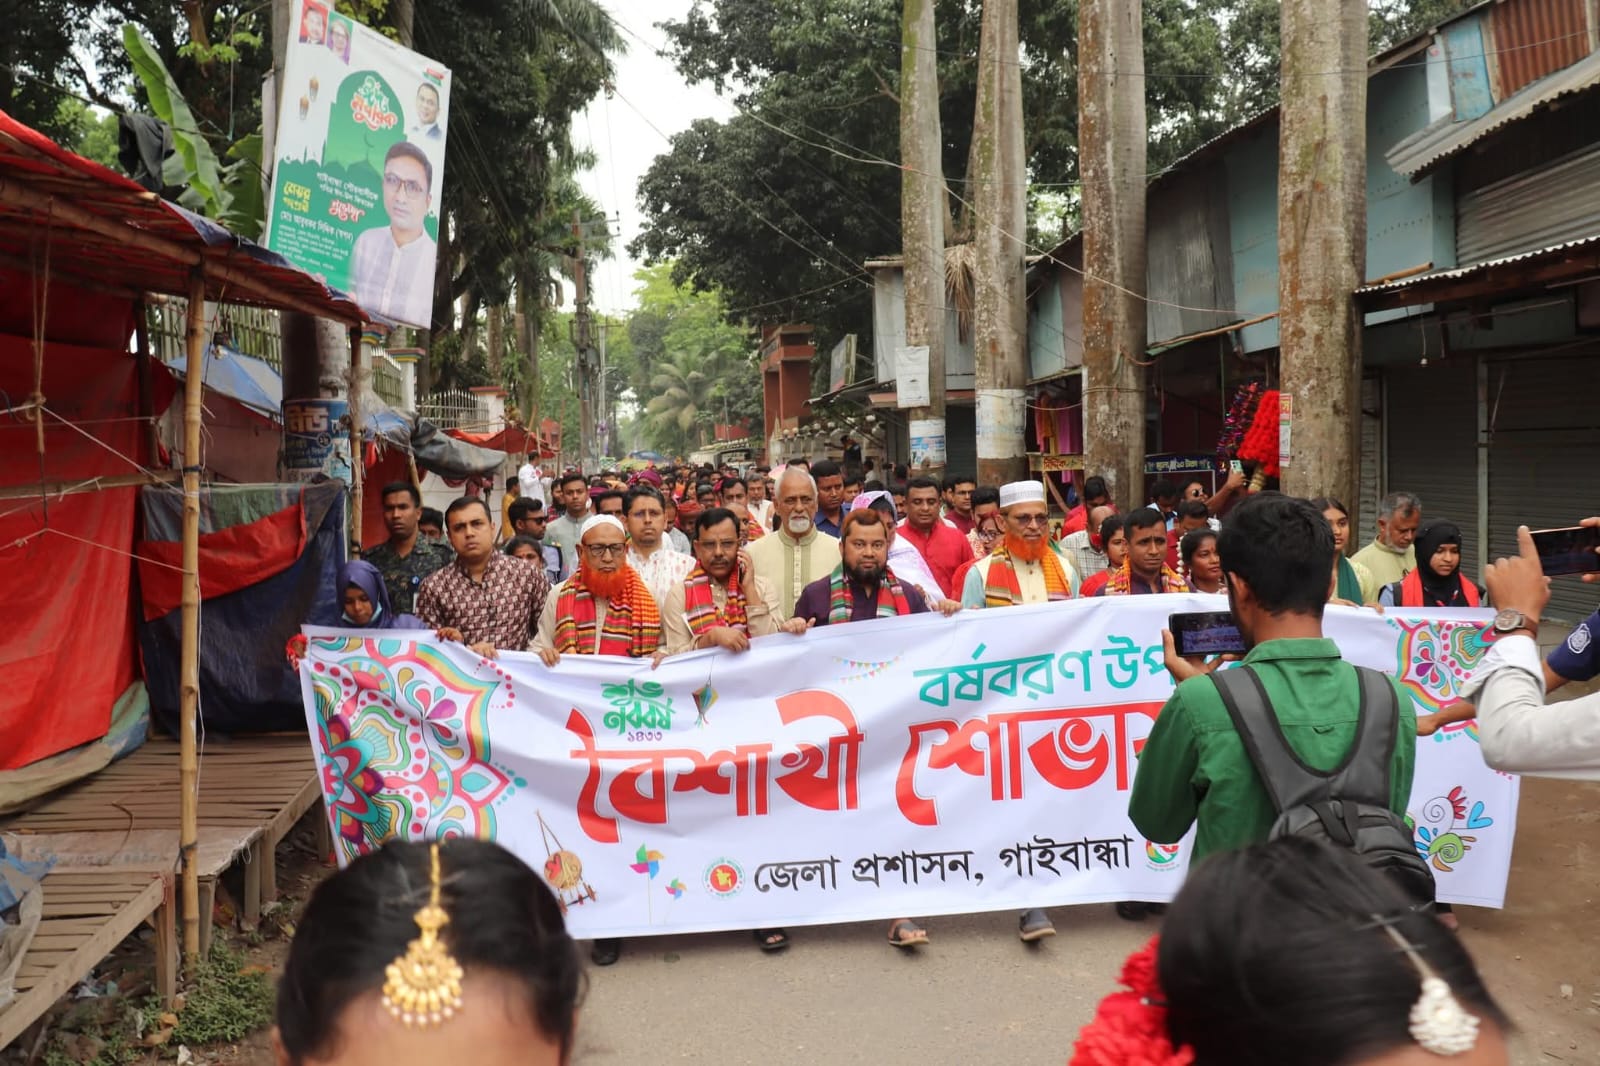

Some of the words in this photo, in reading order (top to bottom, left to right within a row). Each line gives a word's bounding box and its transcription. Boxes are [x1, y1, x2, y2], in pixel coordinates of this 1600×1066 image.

[601, 678, 664, 705] শুভ
[914, 642, 1093, 707] বর্ষবরণ
[1101, 635, 1175, 690] উপ
[603, 698, 676, 736] নববর্ষ
[628, 731, 663, 742] ১৪৩৩
[566, 690, 866, 844] বৈশাখী
[895, 700, 1167, 827] শোভা
[754, 855, 840, 892] জেলা
[852, 850, 984, 888] প্রশাসন,
[999, 834, 1134, 879] গাইবান্ধা
